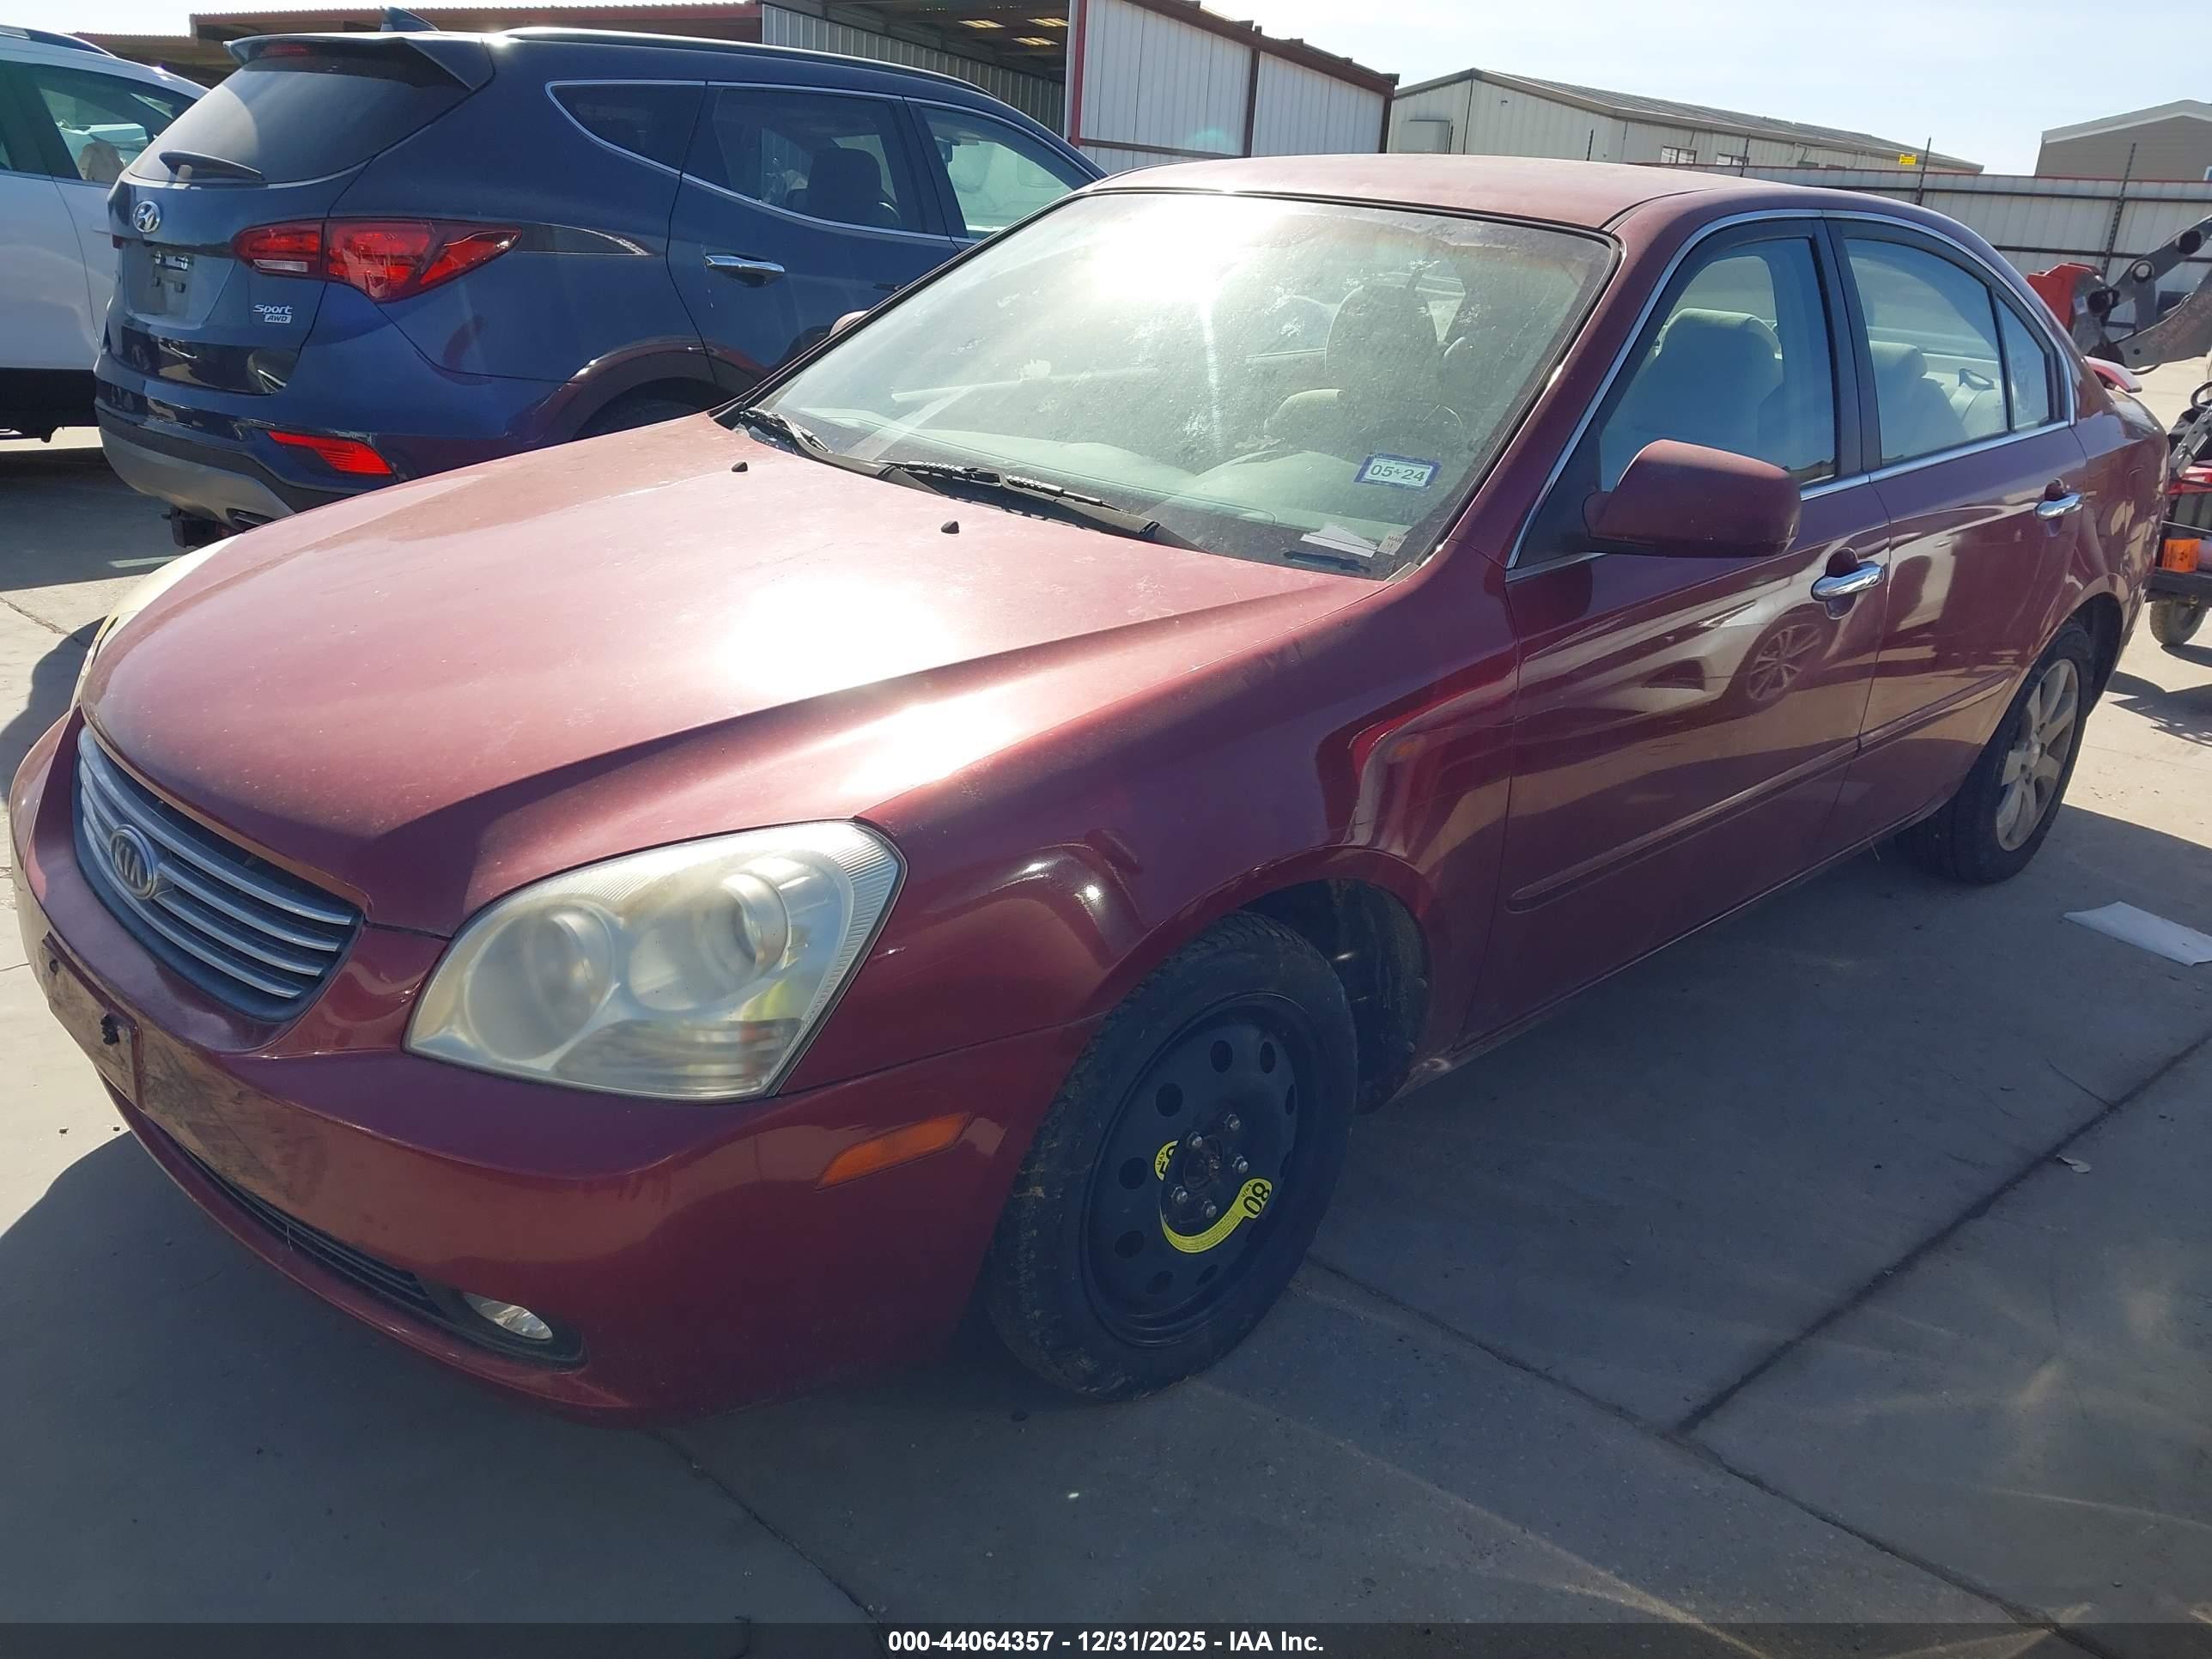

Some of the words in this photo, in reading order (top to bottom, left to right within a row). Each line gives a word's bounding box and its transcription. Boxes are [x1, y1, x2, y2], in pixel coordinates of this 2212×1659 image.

[252, 304, 293, 315] Sport
[265, 314, 290, 323] AWD
[114, 837, 143, 888] KIA
[1243, 1182, 1270, 1215] 80
